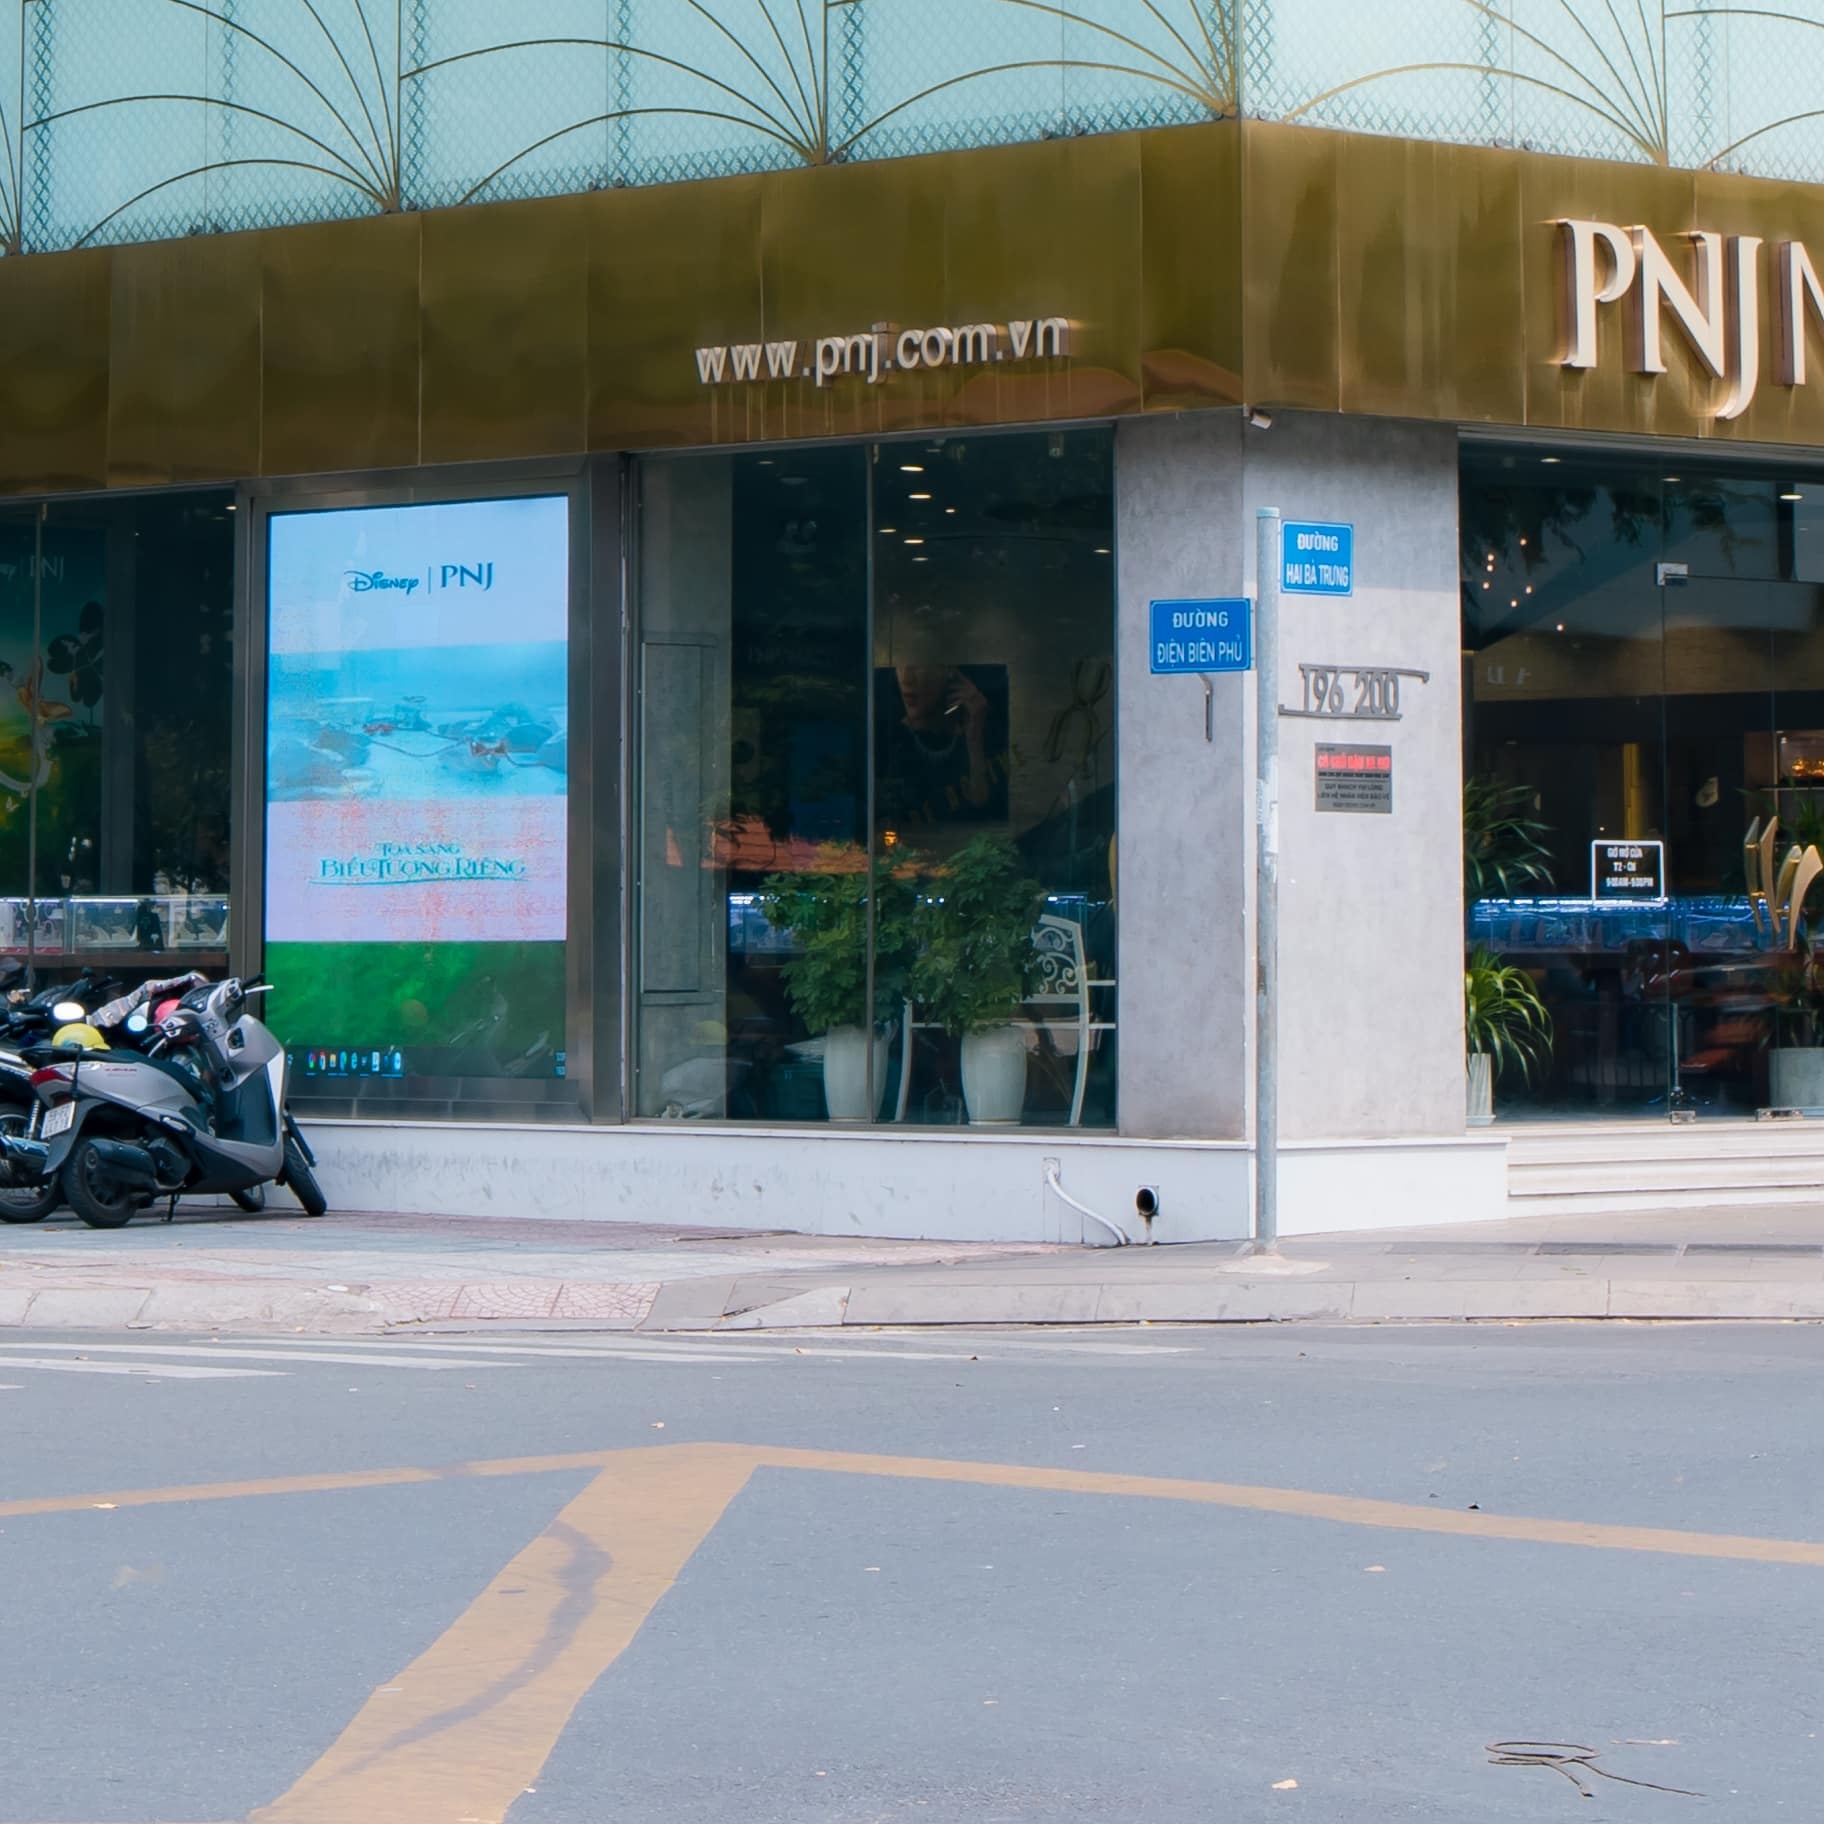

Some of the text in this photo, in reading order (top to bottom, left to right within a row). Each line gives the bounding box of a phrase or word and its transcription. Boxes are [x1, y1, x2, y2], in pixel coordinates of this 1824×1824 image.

[695, 317, 1072, 388] www.pnj.com.vn
[1297, 530, 1339, 552] ĐƯỜNG
[440, 561, 494, 591] PNJ
[1286, 558, 1349, 588] HAI BÀ TRƯNG
[1173, 608, 1229, 628] ĐƯỜNG
[1157, 634, 1243, 667] ĐIỆN BIÊN PHỦ
[1299, 668, 1401, 715] 196 200
